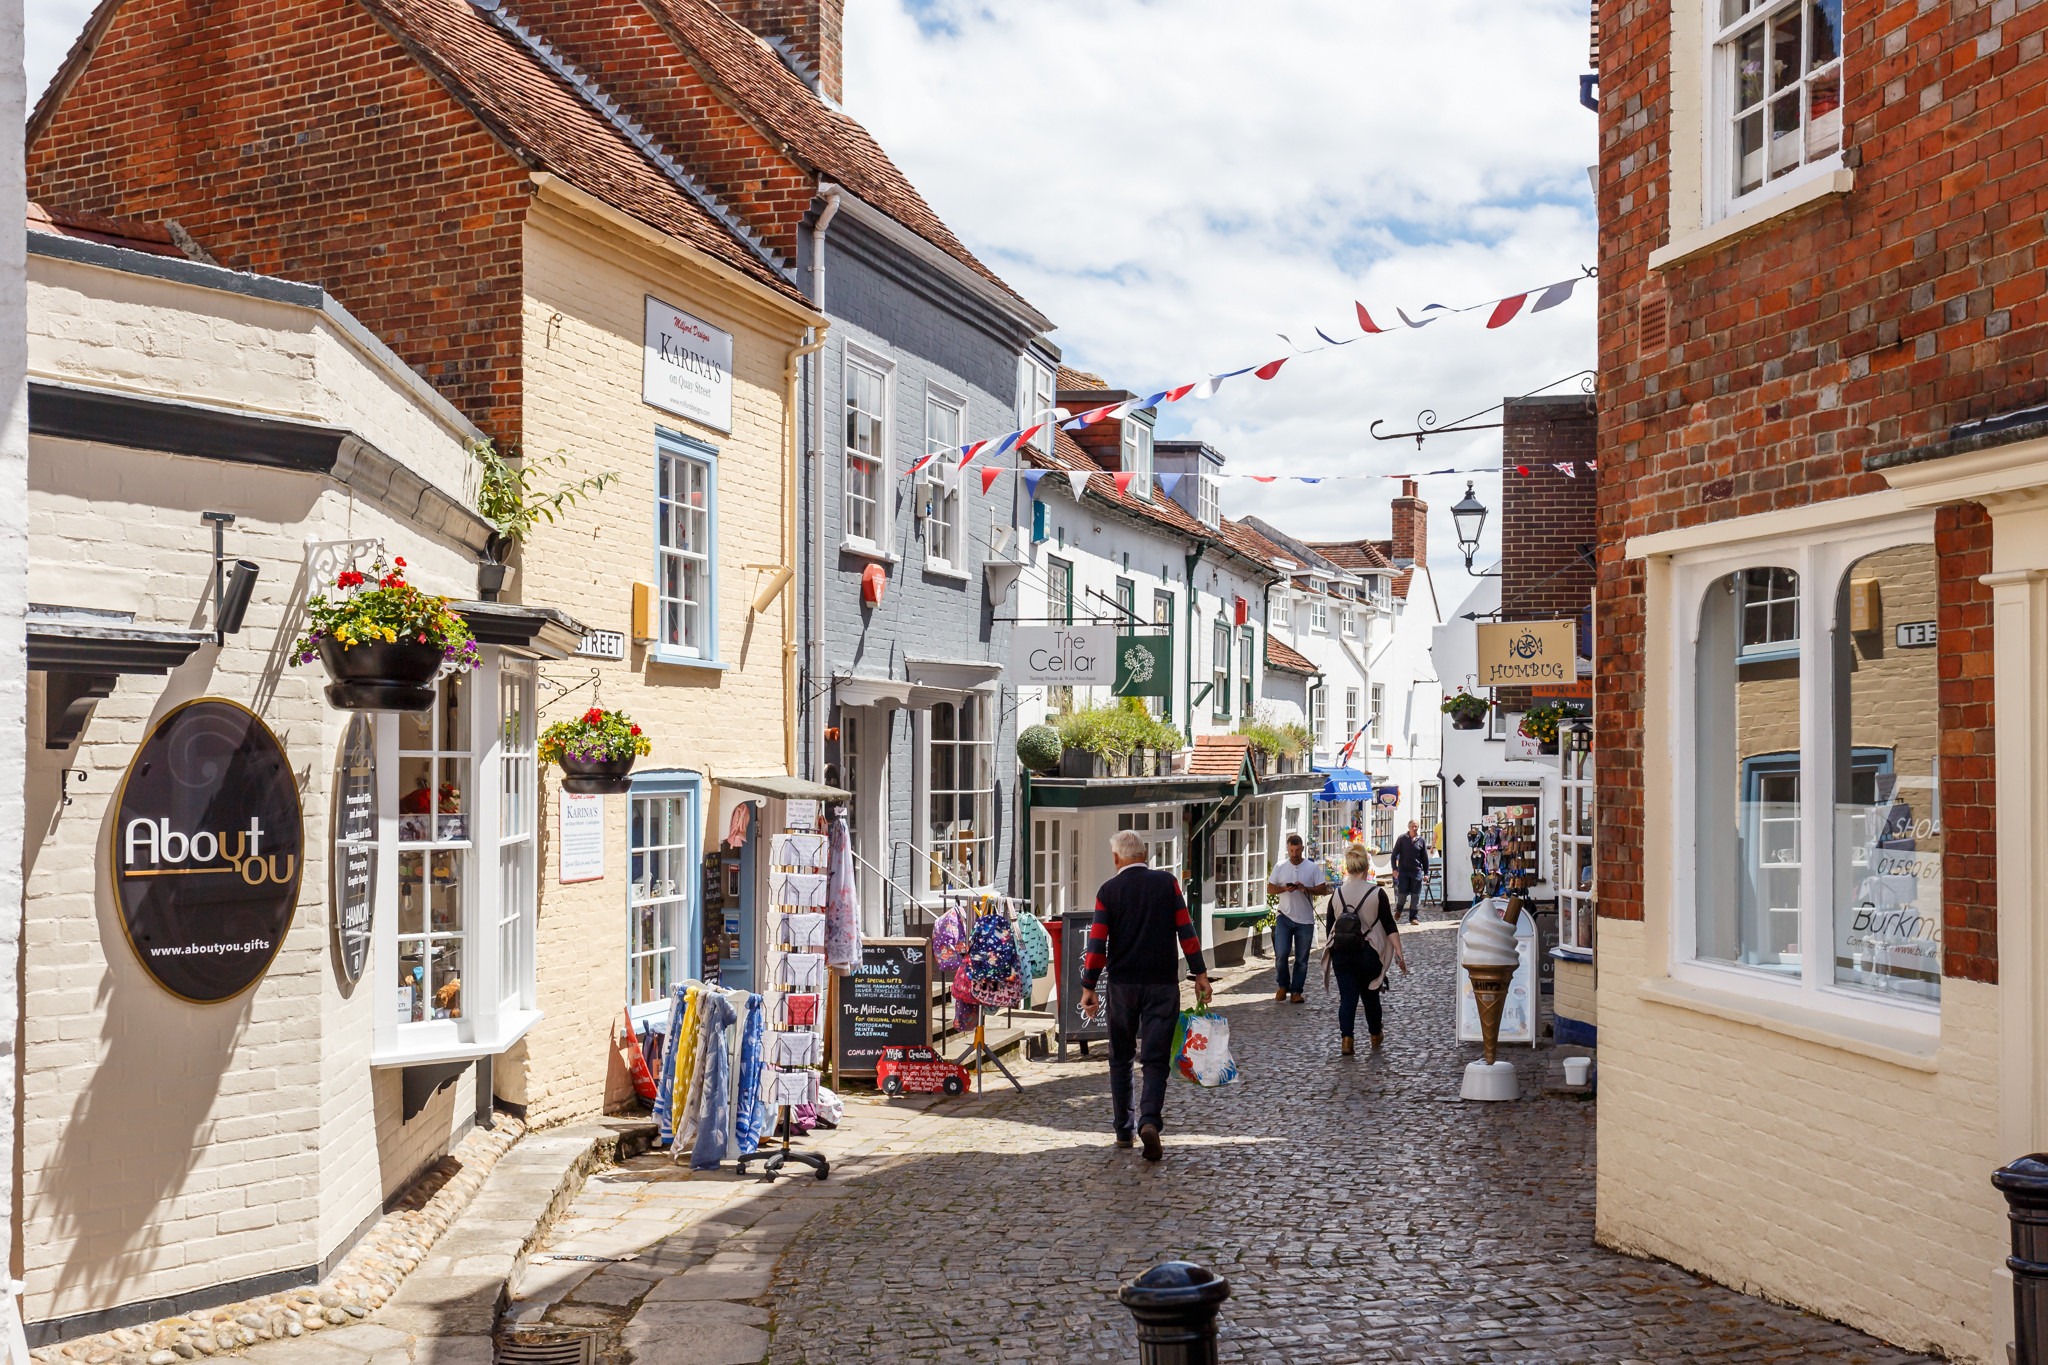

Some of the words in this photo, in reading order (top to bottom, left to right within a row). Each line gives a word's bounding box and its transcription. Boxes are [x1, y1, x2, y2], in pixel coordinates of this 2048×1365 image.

[674, 316, 692, 334] Milford
[693, 325, 710, 342] Designs
[660, 332, 721, 383] KARINA'S
[670, 374, 677, 385] on
[679, 375, 693, 391] Quay
[695, 382, 711, 398] Street
[1054, 631, 1085, 649] The
[1029, 649, 1096, 671] Cellar
[1489, 662, 1564, 681] HUMBUG
[1339, 782, 1348, 791] OUT
[1357, 781, 1368, 791] BLUE
[567, 805, 598, 819] KARINA'S
[1877, 857, 1922, 878] 01590
[1923, 861, 1941, 880] 67
[150, 938, 270, 957] www.aboutyou.gifts
[877, 945, 886, 953] to
[843, 1004, 859, 1015] The
[860, 1003, 887, 1015] Milford
[889, 1004, 918, 1018] Gallery
[886, 1049, 903, 1060] Wife
